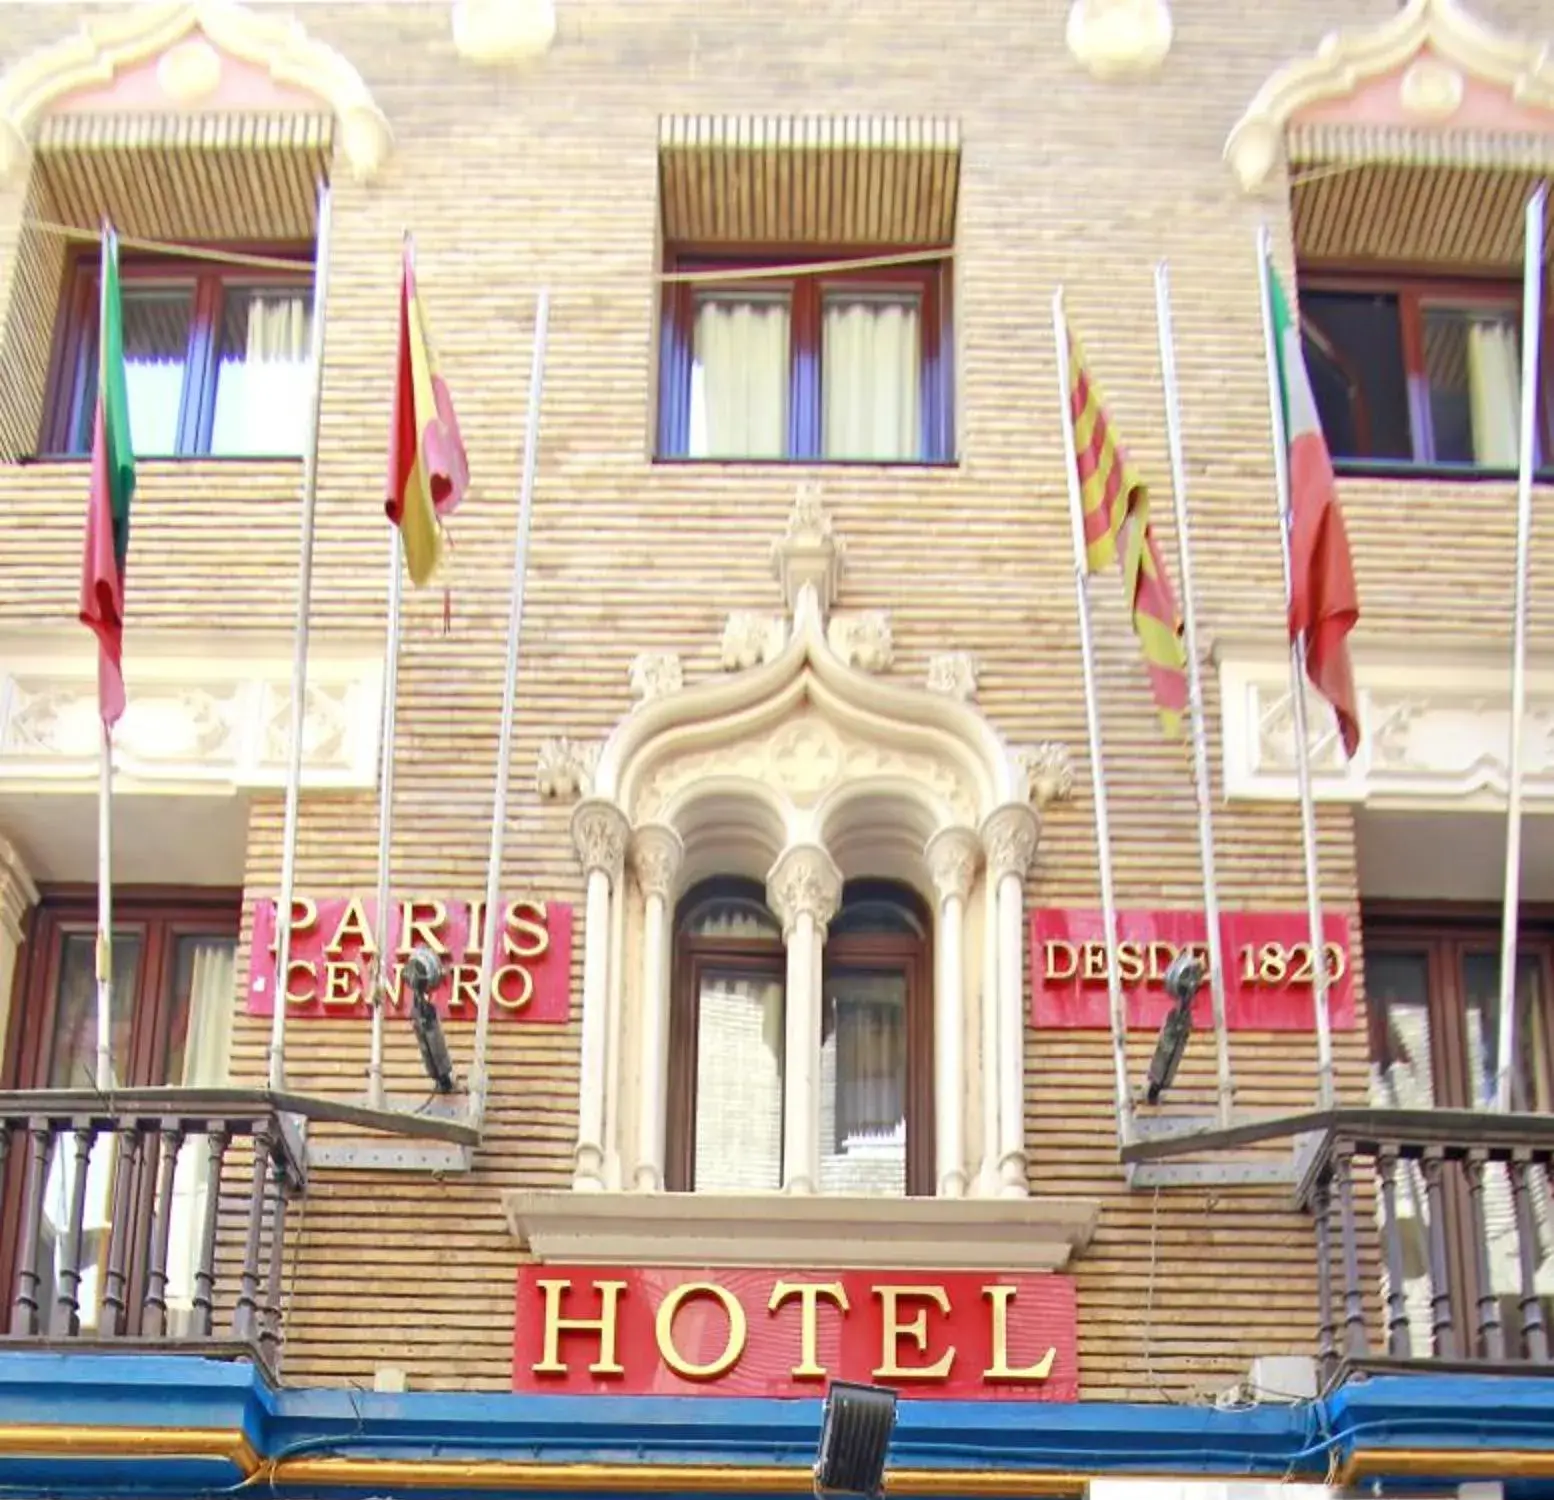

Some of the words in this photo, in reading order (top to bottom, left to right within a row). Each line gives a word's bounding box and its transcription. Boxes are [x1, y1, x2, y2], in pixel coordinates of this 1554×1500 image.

[268, 896, 549, 956] PARIS
[284, 960, 533, 1008] CENRO
[1239, 942, 1345, 983] 1820
[532, 1279, 1057, 1380] HOTEL
